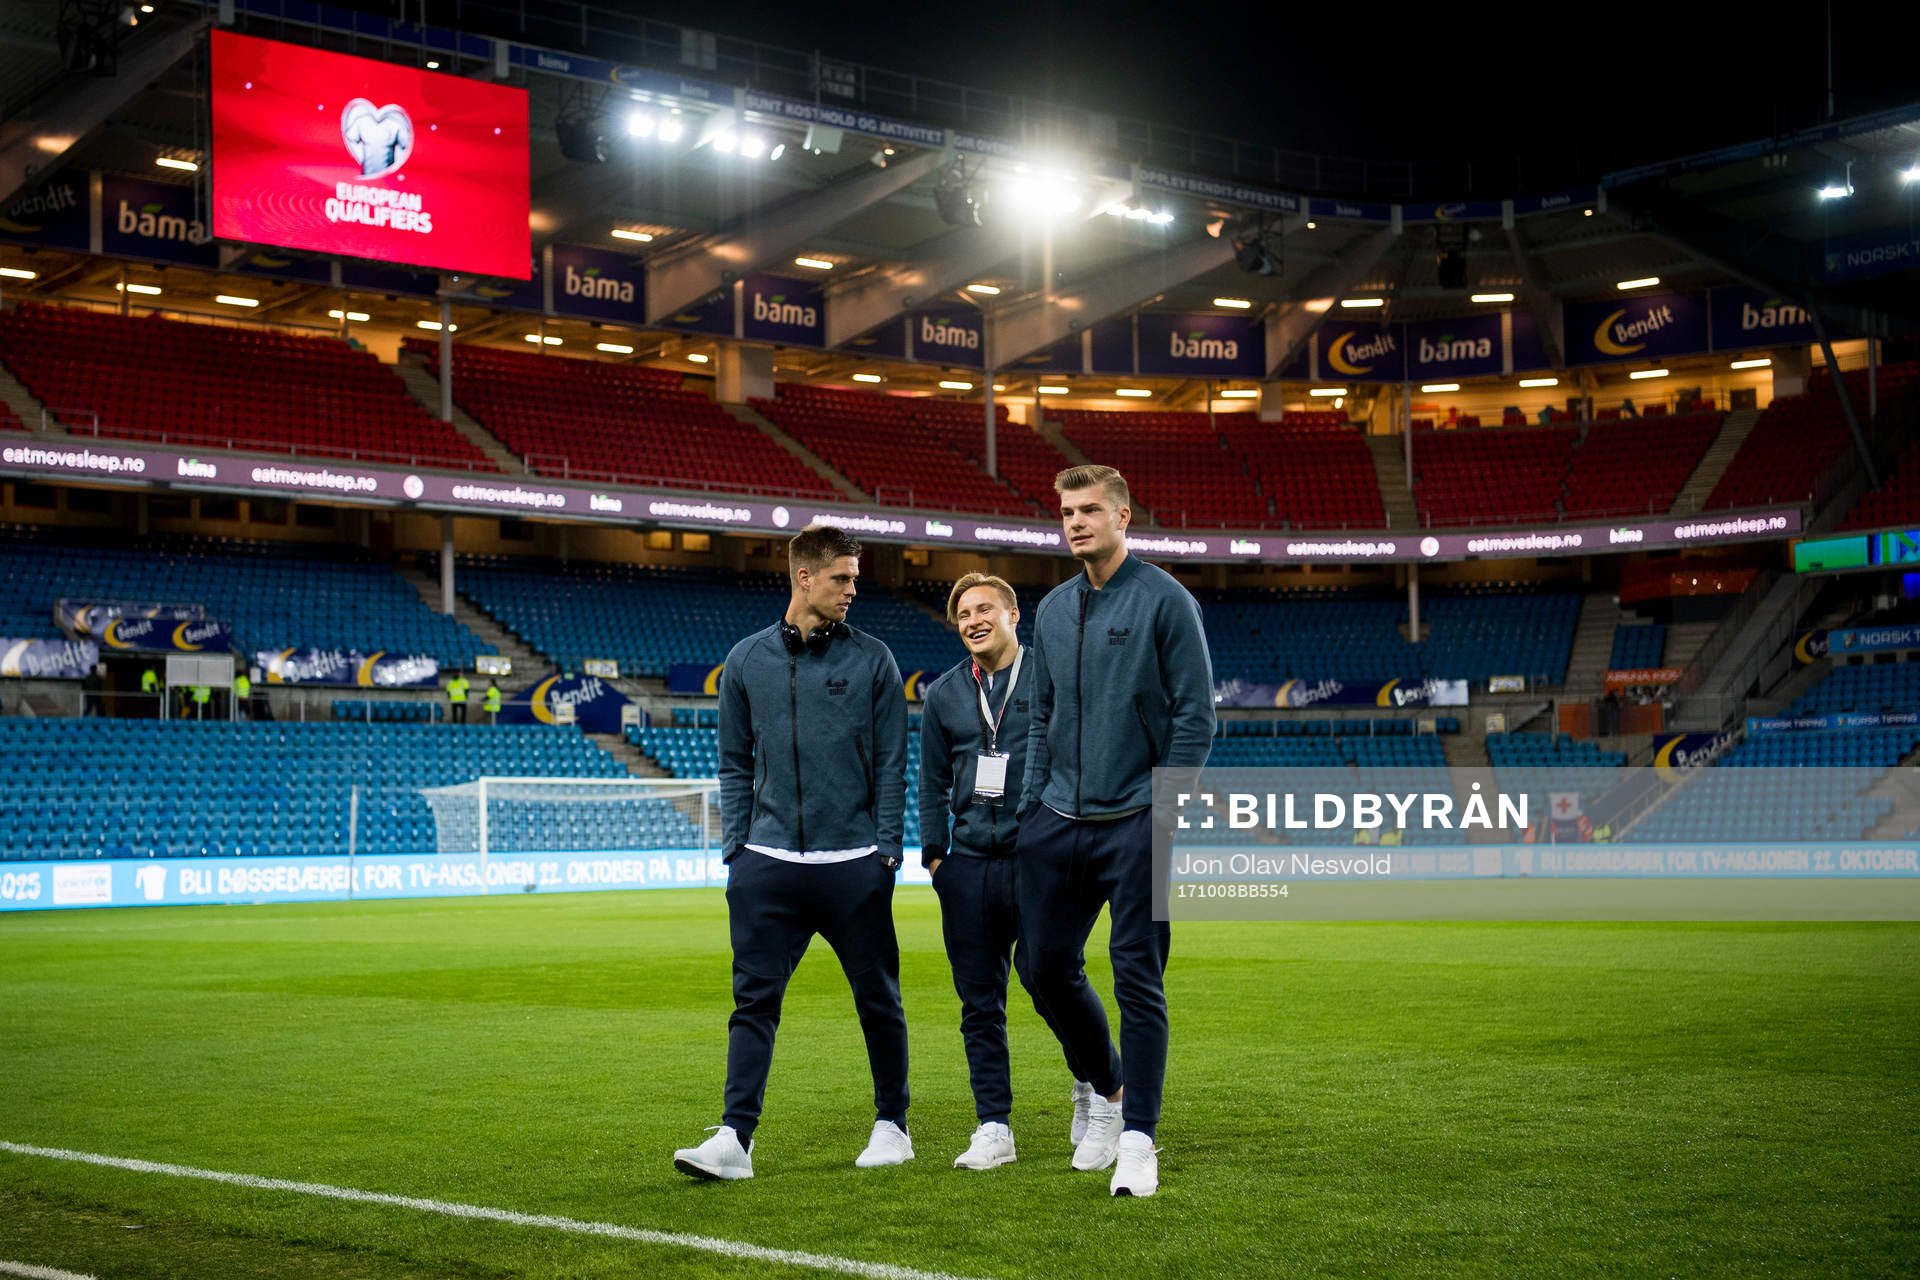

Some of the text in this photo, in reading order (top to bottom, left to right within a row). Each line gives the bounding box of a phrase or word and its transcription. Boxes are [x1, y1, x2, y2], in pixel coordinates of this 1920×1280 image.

[336, 182, 422, 212] EUROPEAN
[118, 199, 206, 244] bama
[325, 197, 433, 234] QUALIFIERS
[1847, 242, 1911, 269] NORSK
[565, 265, 635, 304] bama
[753, 292, 817, 329] bama
[1614, 304, 1673, 344] Bendit
[1741, 302, 1813, 332] bam
[921, 316, 979, 351] bama
[1170, 331, 1238, 361] bama
[1345, 333, 1396, 364] Bendit
[1419, 336, 1492, 365] bama
[3, 447, 145, 473] eatmovesleep.no
[252, 467, 377, 492] eatmovesleep.no
[452, 485, 566, 508] eatmovesleep.no
[1467, 533, 1582, 552] eatmovesleep.no
[1674, 516, 1787, 539] eatmovesleep.no
[1860, 629, 1911, 646] NORSK
[26, 639, 90, 677] Bendit
[180, 868, 212, 895] BLI
[218, 865, 359, 894] BØSSEBÆRER
[364, 864, 403, 890] FOR
[567, 859, 646, 884] OKTOBER
[649, 855, 672, 881] PÅ
[1839, 849, 1919, 872] OKTOBER
